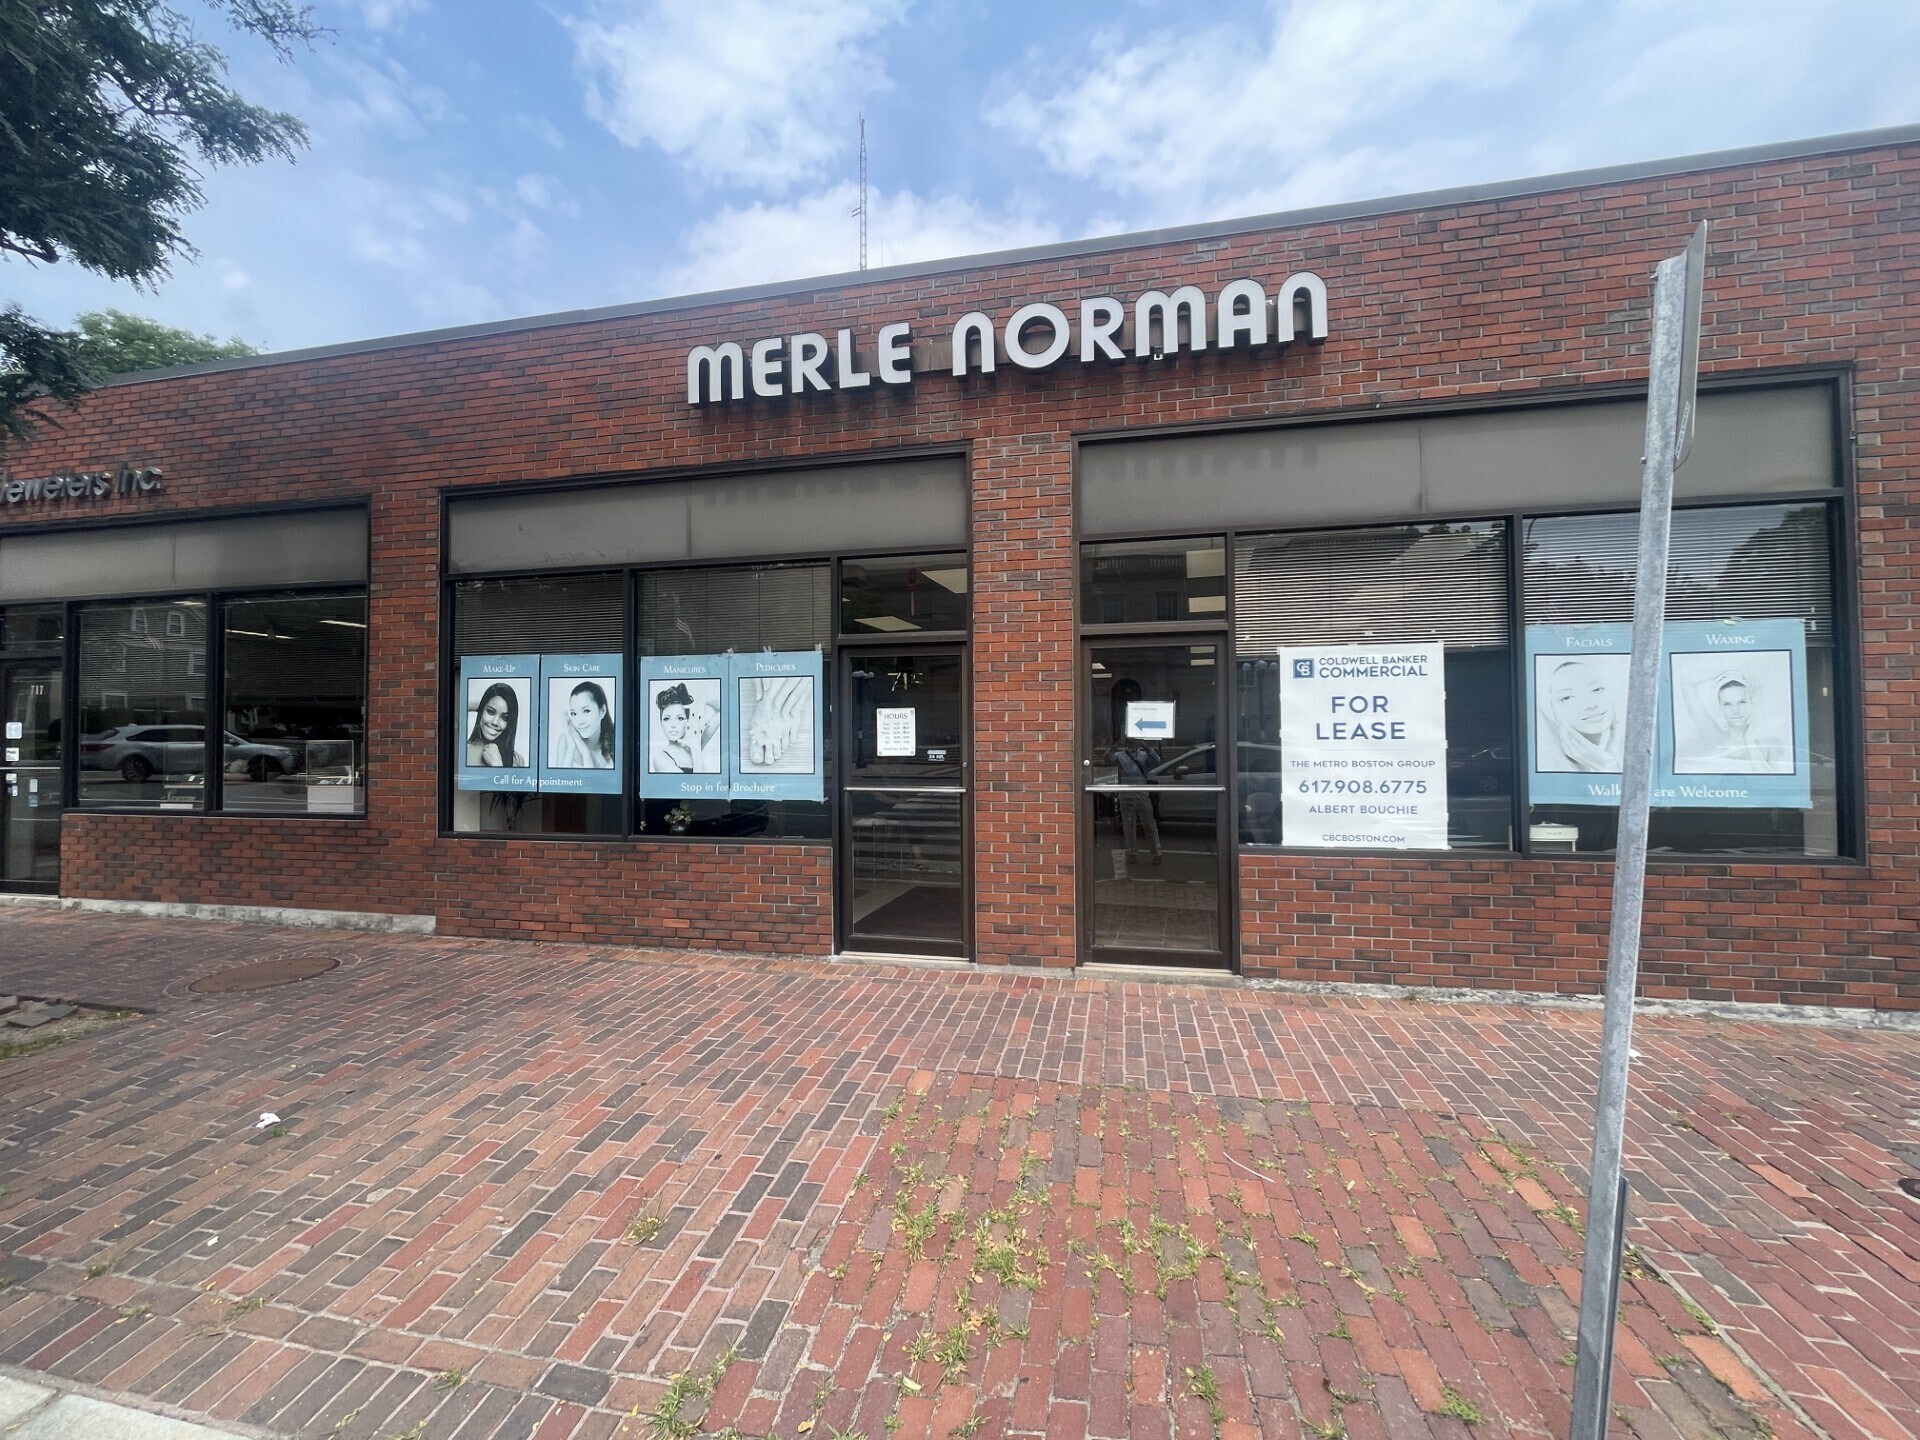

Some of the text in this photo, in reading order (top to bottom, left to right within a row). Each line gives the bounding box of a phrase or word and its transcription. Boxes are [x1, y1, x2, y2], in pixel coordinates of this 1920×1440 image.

[687, 271, 1328, 404] MERLE NORMAN
[114, 461, 163, 494] Inc.
[1319, 655, 1428, 666] COLDWELL BANKER
[1319, 665, 1428, 679] COMMERCIAL
[1331, 695, 1389, 714] FOR
[1316, 721, 1406, 740] LEASE
[1291, 760, 1436, 768] THE METRO BOSTON GROUP
[493, 774, 583, 788] Call for Appointment
[680, 781, 775, 795] Stop in for Brochure
[1299, 780, 1427, 794] 617.908.6775
[1588, 784, 1748, 798] Walk are Welcome
[1308, 805, 1418, 815] ALBERT BOUCHIE
[1322, 834, 1405, 843] CBCBOSTON.COM
